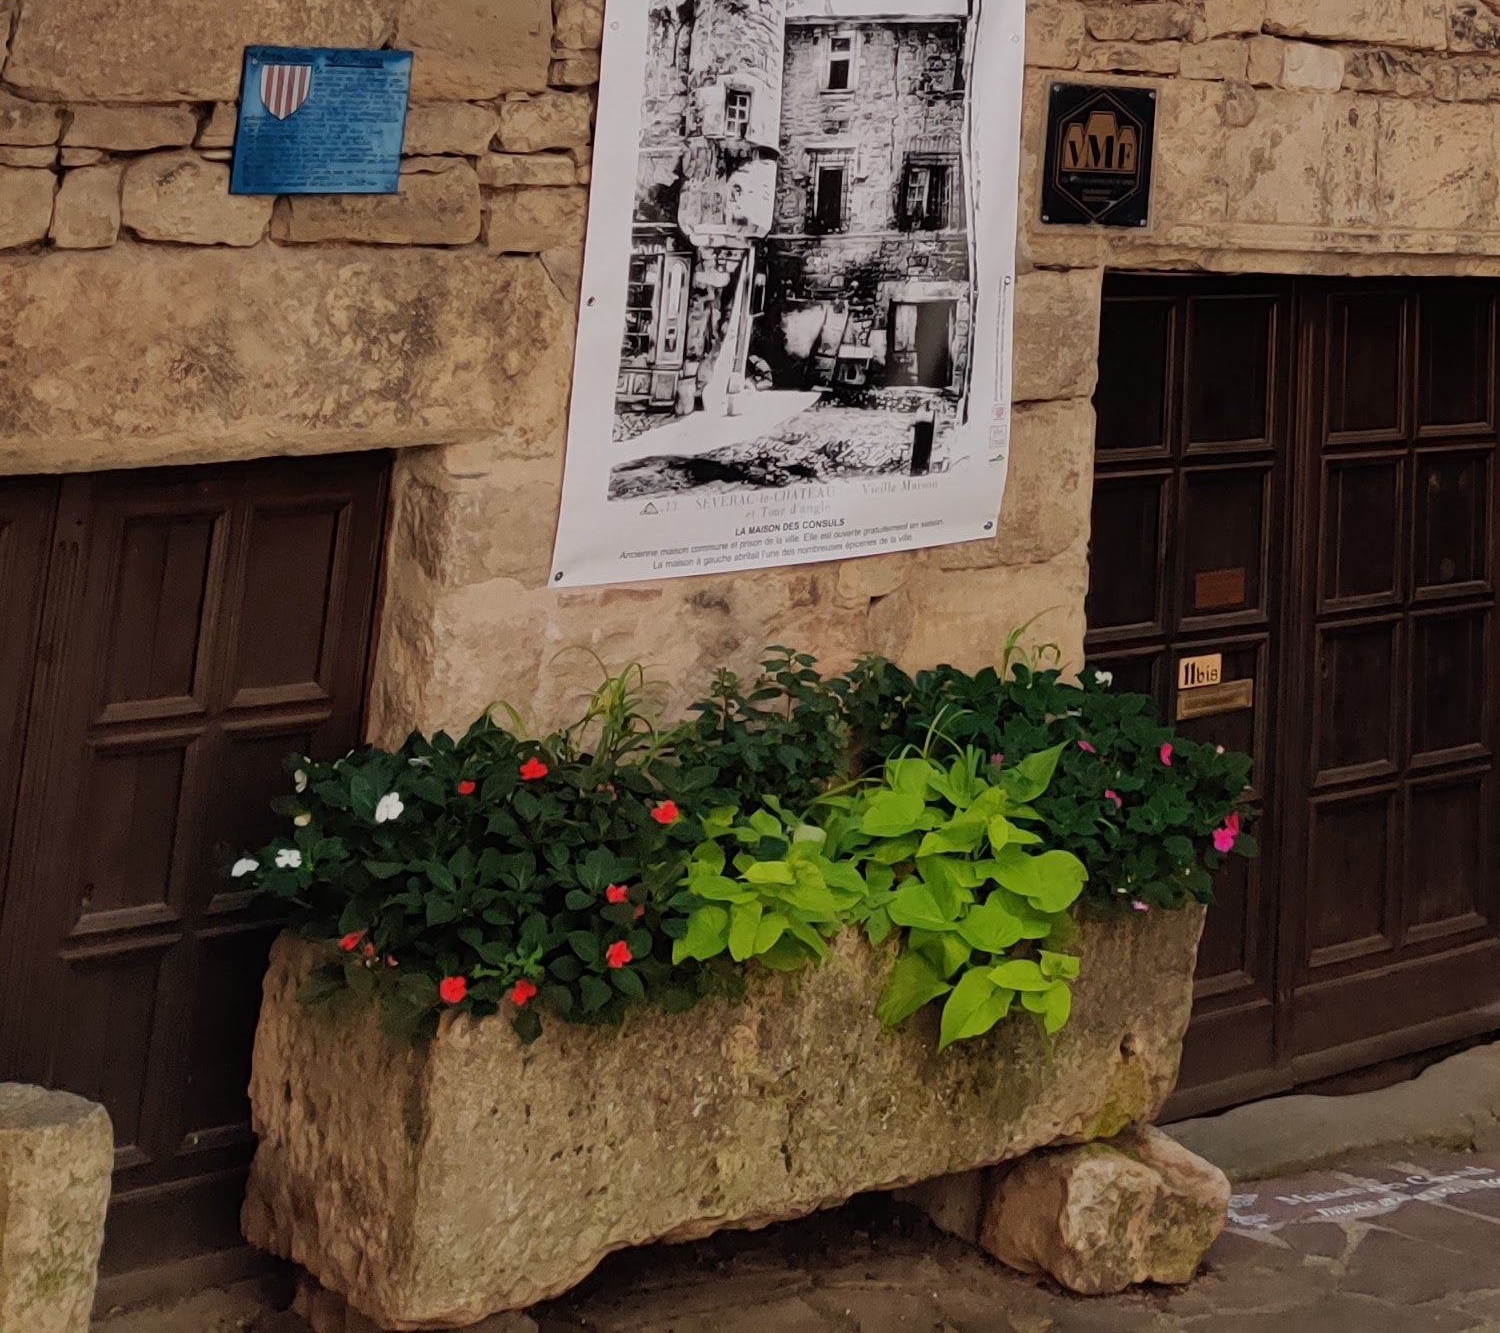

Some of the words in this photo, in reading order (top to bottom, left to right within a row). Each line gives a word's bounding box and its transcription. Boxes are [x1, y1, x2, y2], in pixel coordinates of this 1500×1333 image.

[1068, 134, 1134, 169] VMF
[735, 527, 746, 536] LA
[748, 524, 780, 535] MAISON
[783, 522, 799, 532] DES
[802, 518, 845, 529] CONSULS
[745, 509, 755, 519] et
[760, 506, 785, 517] Tour
[619, 549, 658, 560] Ancienne
[660, 547, 688, 556] maison
[690, 542, 728, 553] commune
[730, 541, 738, 549] et
[739, 539, 763, 549] prison
[764, 537, 774, 546] de
[776, 536, 782, 544] la
[804, 533, 818, 542] Elle
[820, 531, 832, 540] est
[833, 528, 862, 539] ouverte
[653, 561, 663, 570] La
[665, 558, 694, 568] maison
[703, 554, 732, 567] gauche
[761, 549, 780, 559] l'une
[782, 548, 796, 556] des
[798, 543, 843, 554] nombreuses
[879, 536, 888, 545] de
